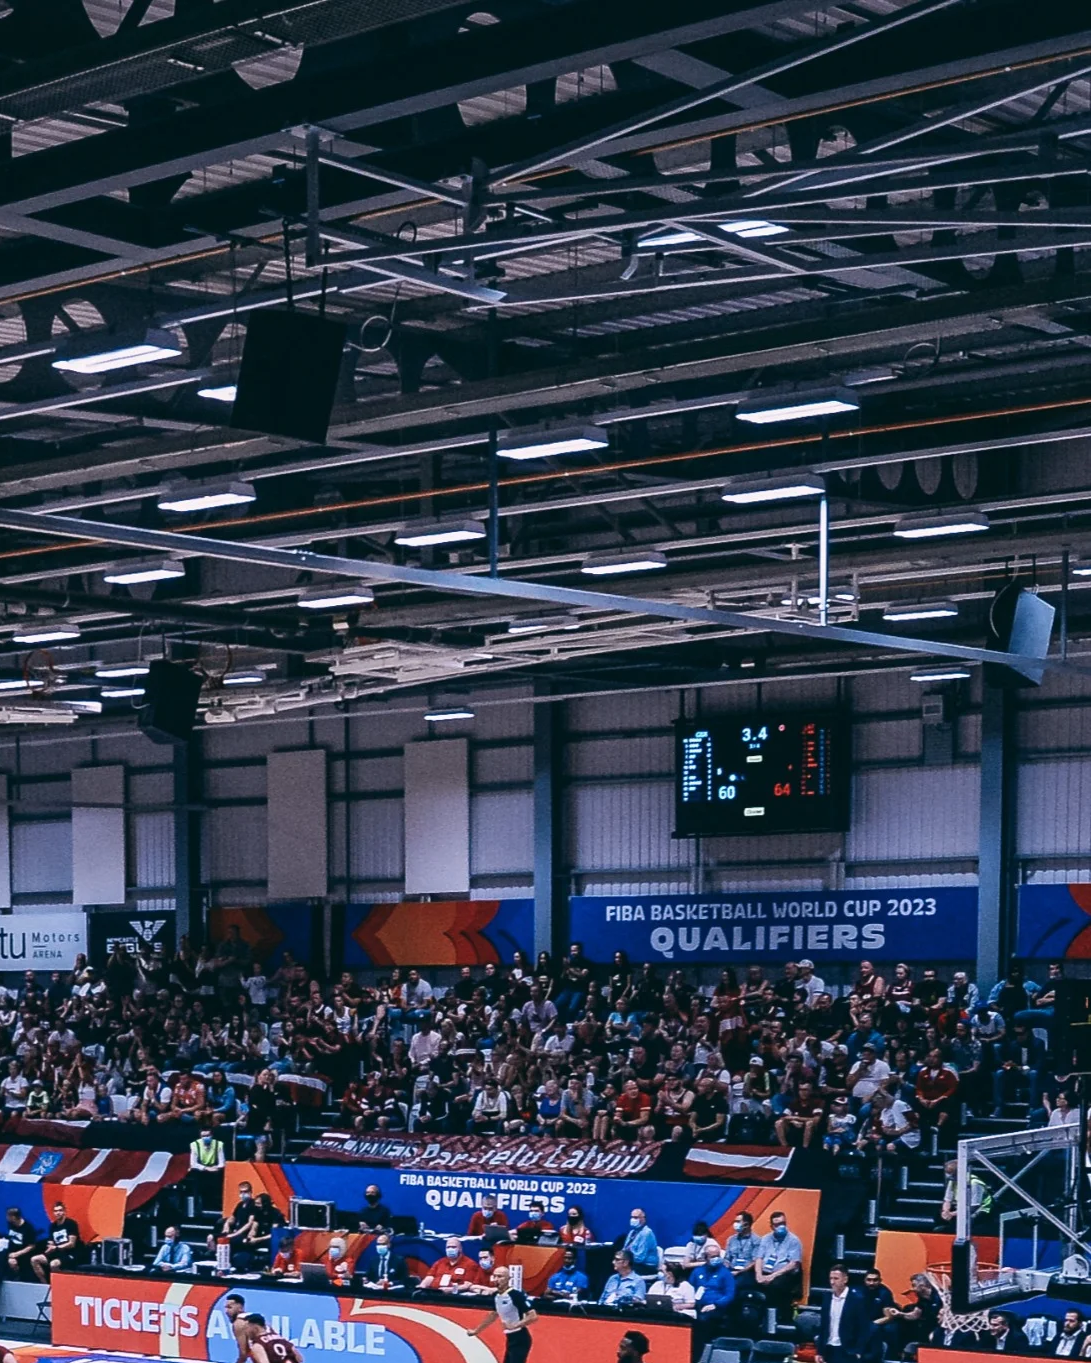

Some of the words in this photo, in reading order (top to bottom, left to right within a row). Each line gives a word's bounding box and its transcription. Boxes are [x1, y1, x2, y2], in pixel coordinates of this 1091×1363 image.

[718, 785, 736, 799] 60
[774, 783, 791, 796] 64
[606, 905, 645, 921] FIBA
[650, 902, 767, 920] BASKETBALL
[773, 901, 837, 918] WORLD
[843, 900, 881, 917] CUP
[888, 898, 937, 916] 2023
[32, 932, 80, 943] Motors
[650, 923, 885, 958] QUALIFIERS
[400, 1174, 424, 1186] FIBA
[427, 1175, 497, 1190] BASKETBALL
[500, 1178, 538, 1193] WORLD
[541, 1181, 564, 1194] CUP
[567, 1182, 596, 1195] 2023
[426, 1189, 565, 1213] QUALFIERS
[75, 1295, 199, 1337] TICKETS
[206, 1310, 386, 1355] AILABLE
